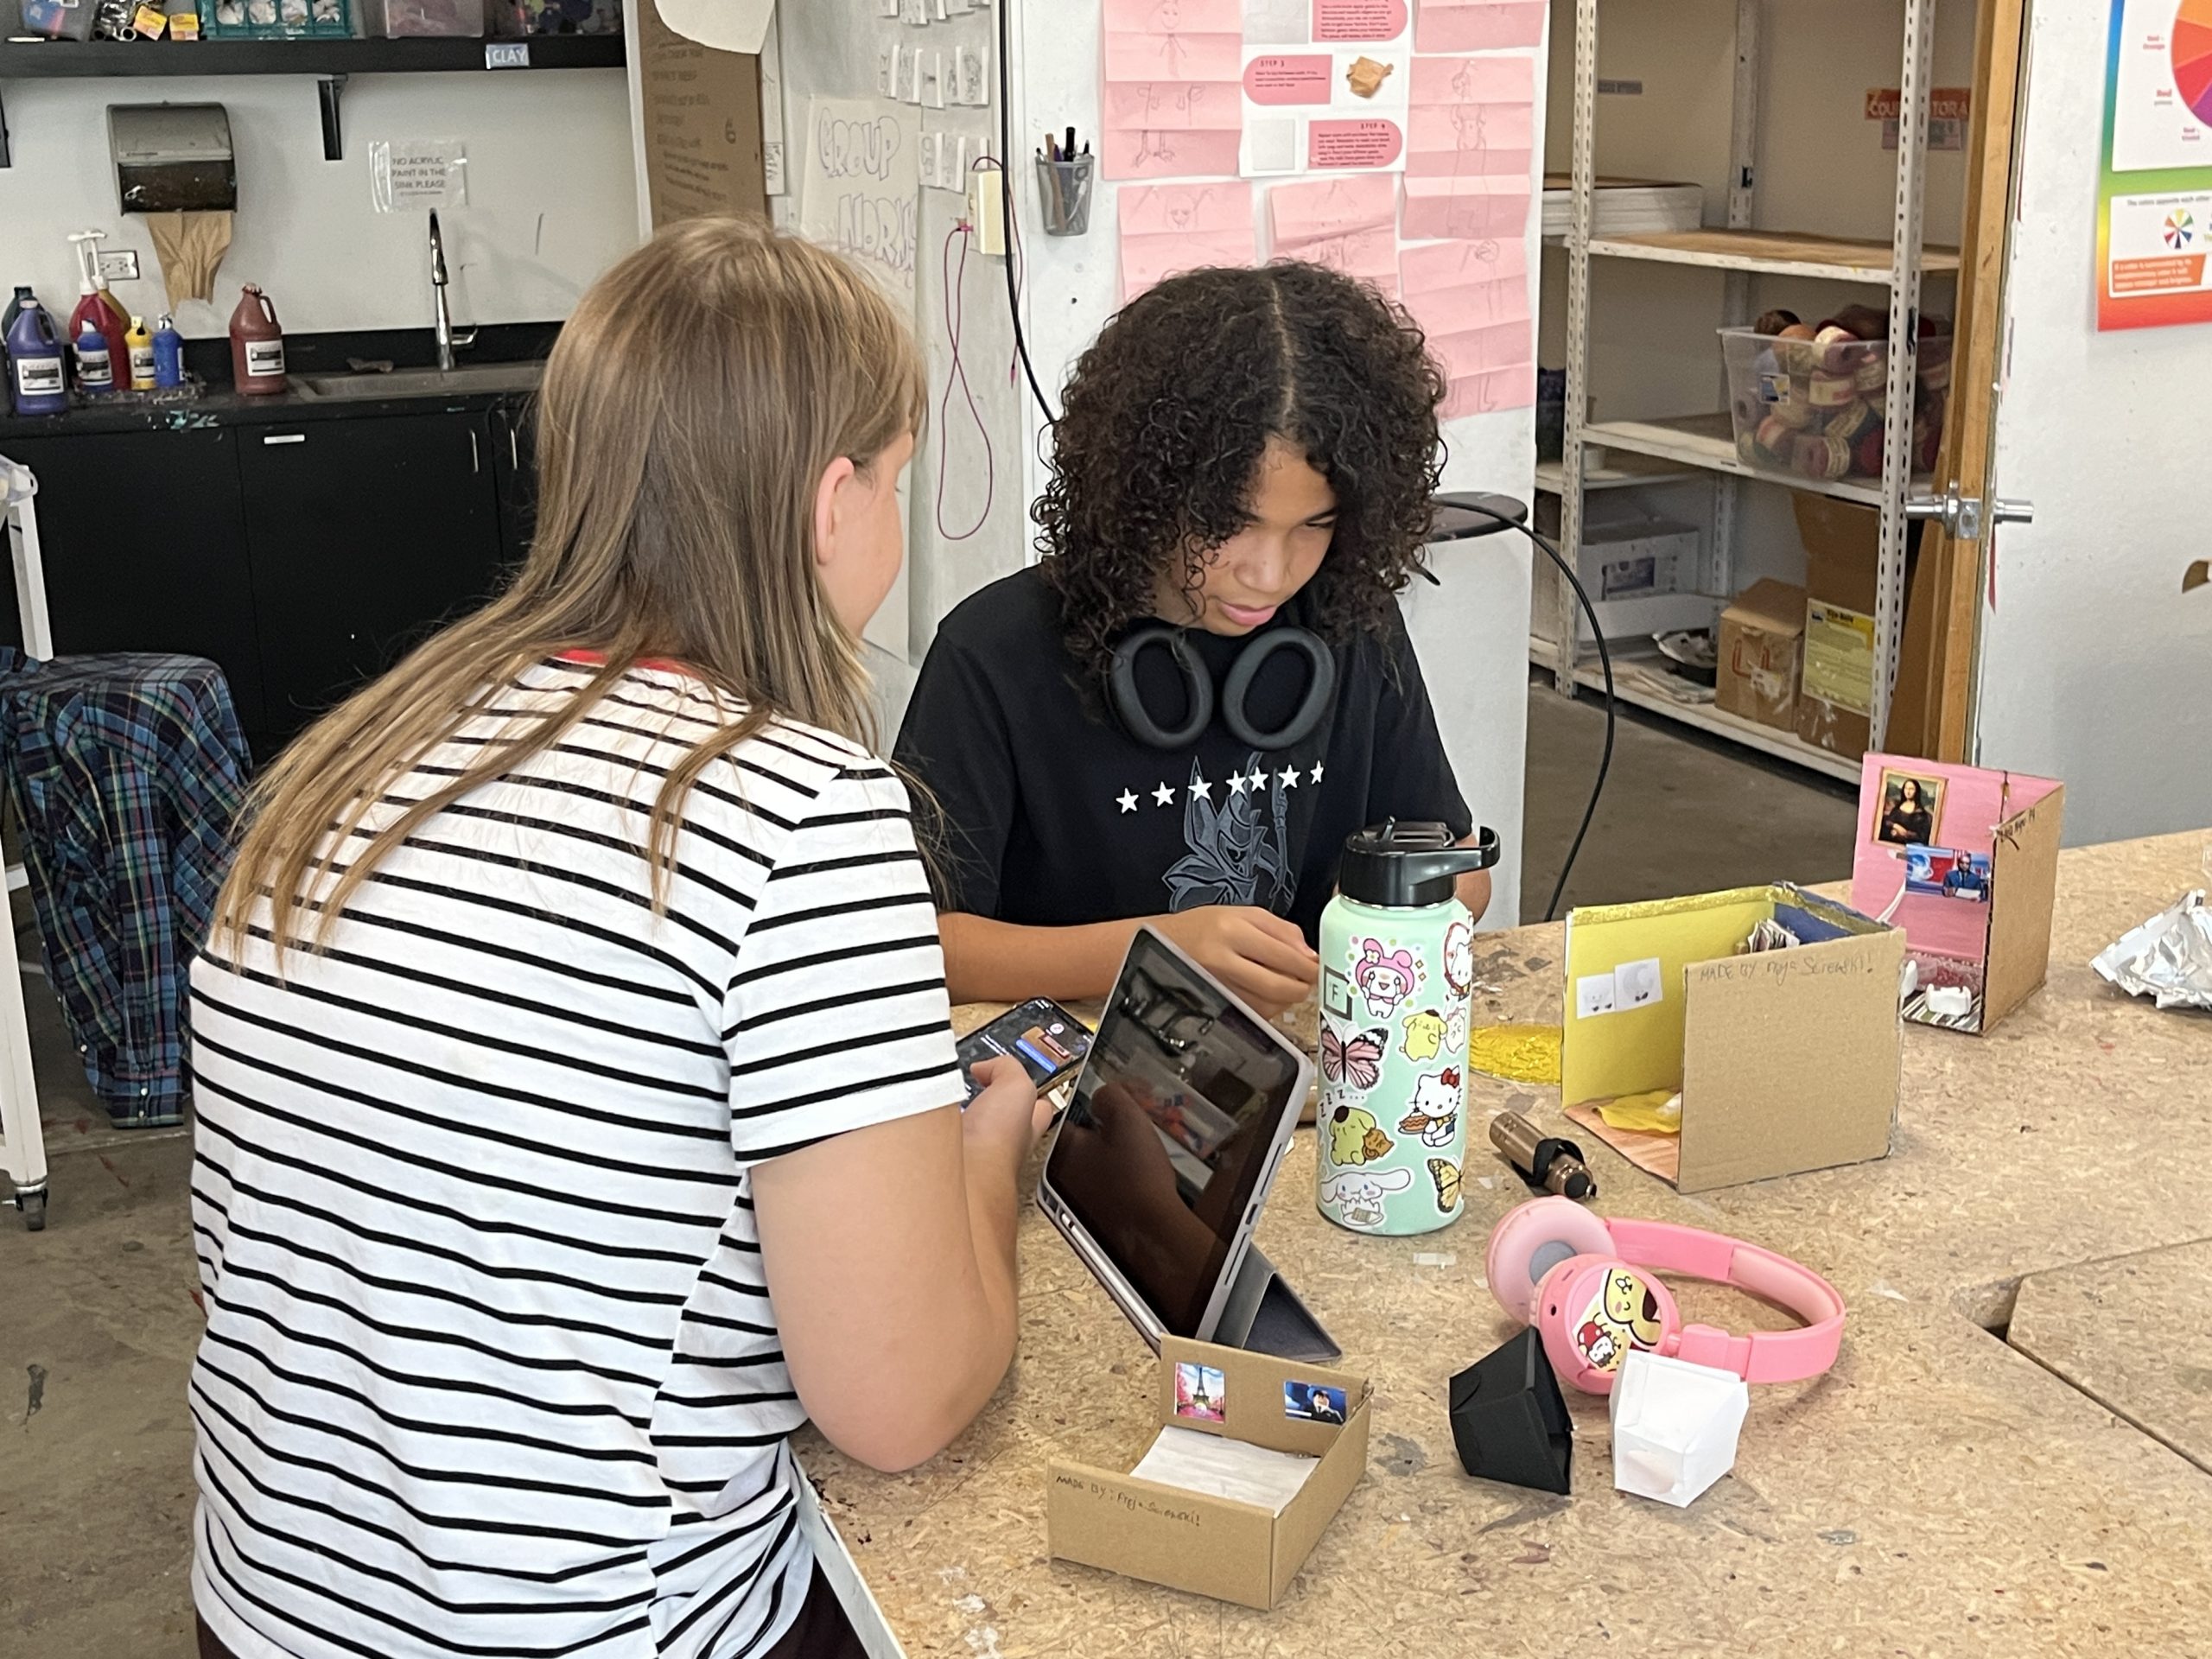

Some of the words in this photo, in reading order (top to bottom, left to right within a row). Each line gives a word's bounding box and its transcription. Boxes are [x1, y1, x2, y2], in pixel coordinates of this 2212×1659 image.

[493, 48, 525, 63] CLAY
[1869, 99, 1900, 117] COU
[1932, 99, 1969, 118] TORA
[818, 106, 901, 181] GROUP
[391, 168, 416, 177] PAINT
[429, 168, 447, 176] THE
[416, 179, 446, 188] PLEASE
[1700, 963, 1733, 982] MADE
[1739, 959, 1758, 980] BY
[1056, 1475, 1084, 1491] MADE
